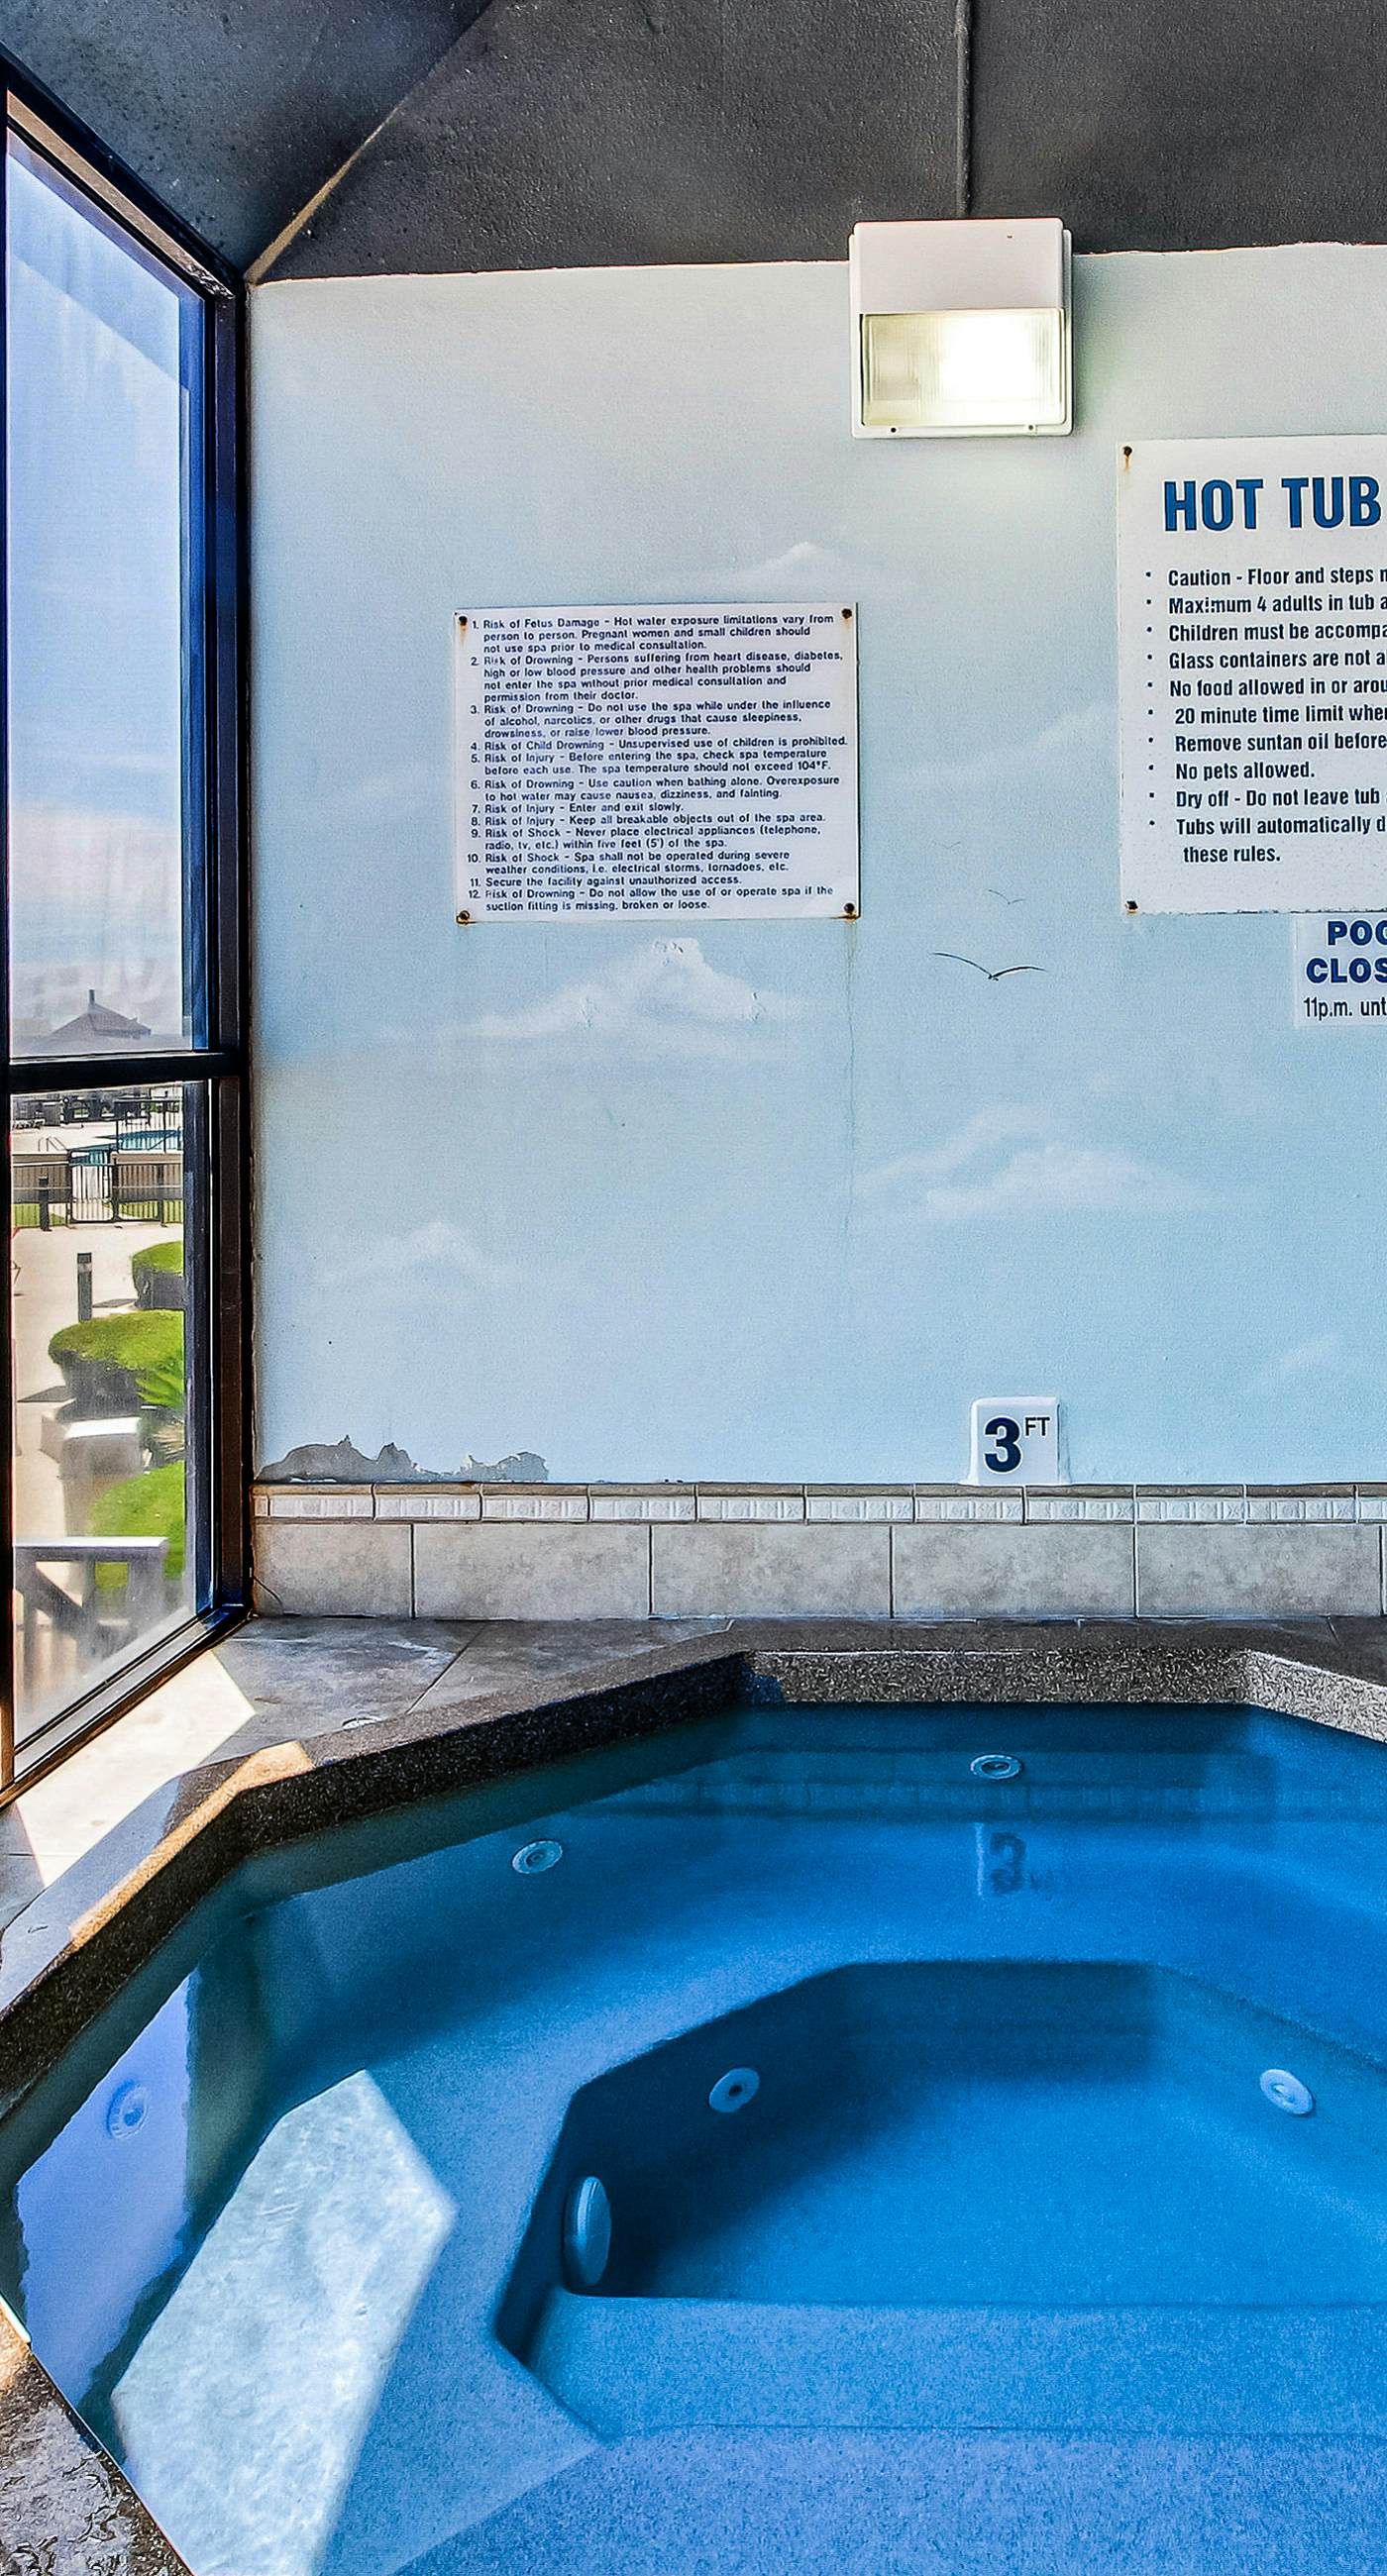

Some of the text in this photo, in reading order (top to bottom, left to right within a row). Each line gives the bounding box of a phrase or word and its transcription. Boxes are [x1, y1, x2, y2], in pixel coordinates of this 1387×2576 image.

[1164, 475, 1381, 531] HOT TUB
[1168, 569, 1230, 585] Caution
[1248, 568, 1289, 584] Floor
[1295, 567, 1324, 583] and
[1330, 567, 1373, 585] steps
[1169, 596, 1251, 612] Maximum
[1256, 596, 1266, 611] 4
[1272, 595, 1322, 611] adults
[1329, 595, 1342, 610] in
[1348, 595, 1374, 610] tub
[472, 618, 479, 629] 1.
[483, 618, 504, 628] Risk
[509, 618, 520, 628] of
[524, 617, 553, 628] Fetus
[557, 616, 599, 629] Damage
[614, 616, 632, 626] Hot
[636, 615, 666, 626] water
[670, 617, 719, 628] exposure
[723, 614, 778, 624] limitations
[782, 616, 804, 626] vary
[808, 613, 833, 623] from
[483, 633, 519, 644] person
[523, 630, 534, 640] to
[538, 632, 577, 642] person.
[581, 628, 627, 642] Pregnant
[674, 627, 694, 637] and
[697, 626, 725, 637] small
[729, 625, 771, 636] children
[775, 625, 810, 635] should
[1169, 625, 1237, 641] Children
[1244, 623, 1284, 639] must
[1289, 623, 1309, 638] be
[1169, 653, 1214, 669] Glass
[1220, 651, 1307, 668] containers
[1313, 653, 1338, 666] are
[1344, 650, 1370, 665] not
[483, 667, 505, 679] high
[524, 667, 542, 676] low
[546, 666, 576, 676] blood
[580, 668, 626, 677] pressure
[630, 665, 650, 674] and
[653, 664, 682, 674] other
[686, 664, 718, 673] health
[721, 663, 771, 675] problems
[776, 662, 810, 672] should
[1170, 678, 1387, 696] No food allowed in or arou
[483, 689, 638, 704] permission from their doctor.
[483, 716, 495, 726] of
[499, 715, 539, 728] alcohol,
[543, 714, 594, 727] narcotics,
[614, 714, 642, 724] other
[646, 713, 676, 726] drugs
[681, 713, 701, 723] that
[742, 711, 801, 724] sleepiness,
[1175, 704, 1387, 724] 20 minute time limit whe
[1175, 732, 1387, 751] Remove suntan oil before
[484, 765, 518, 775] before
[523, 765, 548, 774] each
[579, 764, 596, 773] The
[601, 766, 620, 775] spa
[624, 762, 690, 775] temperature
[694, 762, 728, 772] should
[732, 761, 749, 772] not
[753, 761, 793, 771] exceed
[1176, 762, 1314, 781] No pets allowed.
[484, 791, 495, 801] to
[499, 791, 516, 801] hot
[521, 790, 550, 801] water
[554, 792, 576, 803] may
[615, 791, 656, 802] nausea,
[660, 788, 711, 801] dizziness,
[715, 788, 735, 798] and
[739, 787, 782, 800] fainting.
[1176, 791, 1202, 810] Dry
[1208, 791, 1228, 806] off
[1246, 790, 1266, 805] Do
[1272, 790, 1298, 805] not
[1304, 789, 1348, 804] leave
[1354, 788, 1379, 804] tub
[472, 803, 480, 814] 7.
[484, 803, 507, 813] Risk
[511, 803, 521, 813] of
[526, 802, 555, 815] Injury
[569, 802, 595, 812] Enter
[600, 801, 620, 812] and
[624, 801, 643, 811] exit
[648, 801, 684, 813] slowly.
[471, 828, 480, 838] 9.
[484, 828, 507, 838] Risk
[511, 827, 522, 838] of
[527, 827, 561, 837] Shock
[575, 826, 605, 837] Never
[610, 826, 639, 839] place
[644, 825, 694, 836] electrical
[697, 824, 755, 837] appliances
[759, 824, 820, 837] (telephone,
[1177, 816, 1387, 836] Tubs will automatically d
[1183, 846, 1280, 862] these rules.
[470, 876, 480, 887] 11.
[485, 876, 521, 886] Secure
[526, 876, 543, 886] the
[547, 876, 583, 888] facility
[587, 876, 624, 887] against
[628, 875, 696, 885] unauthorized
[485, 900, 523, 911] suction
[527, 900, 558, 913] fitting
[562, 900, 571, 910] is
[575, 899, 618, 912] missing,
[622, 899, 658, 909] broken
[678, 898, 709, 909] loose.
[1304, 997, 1352, 1021] 11p.m.
[985, 1417, 1050, 1473] 3 FT
